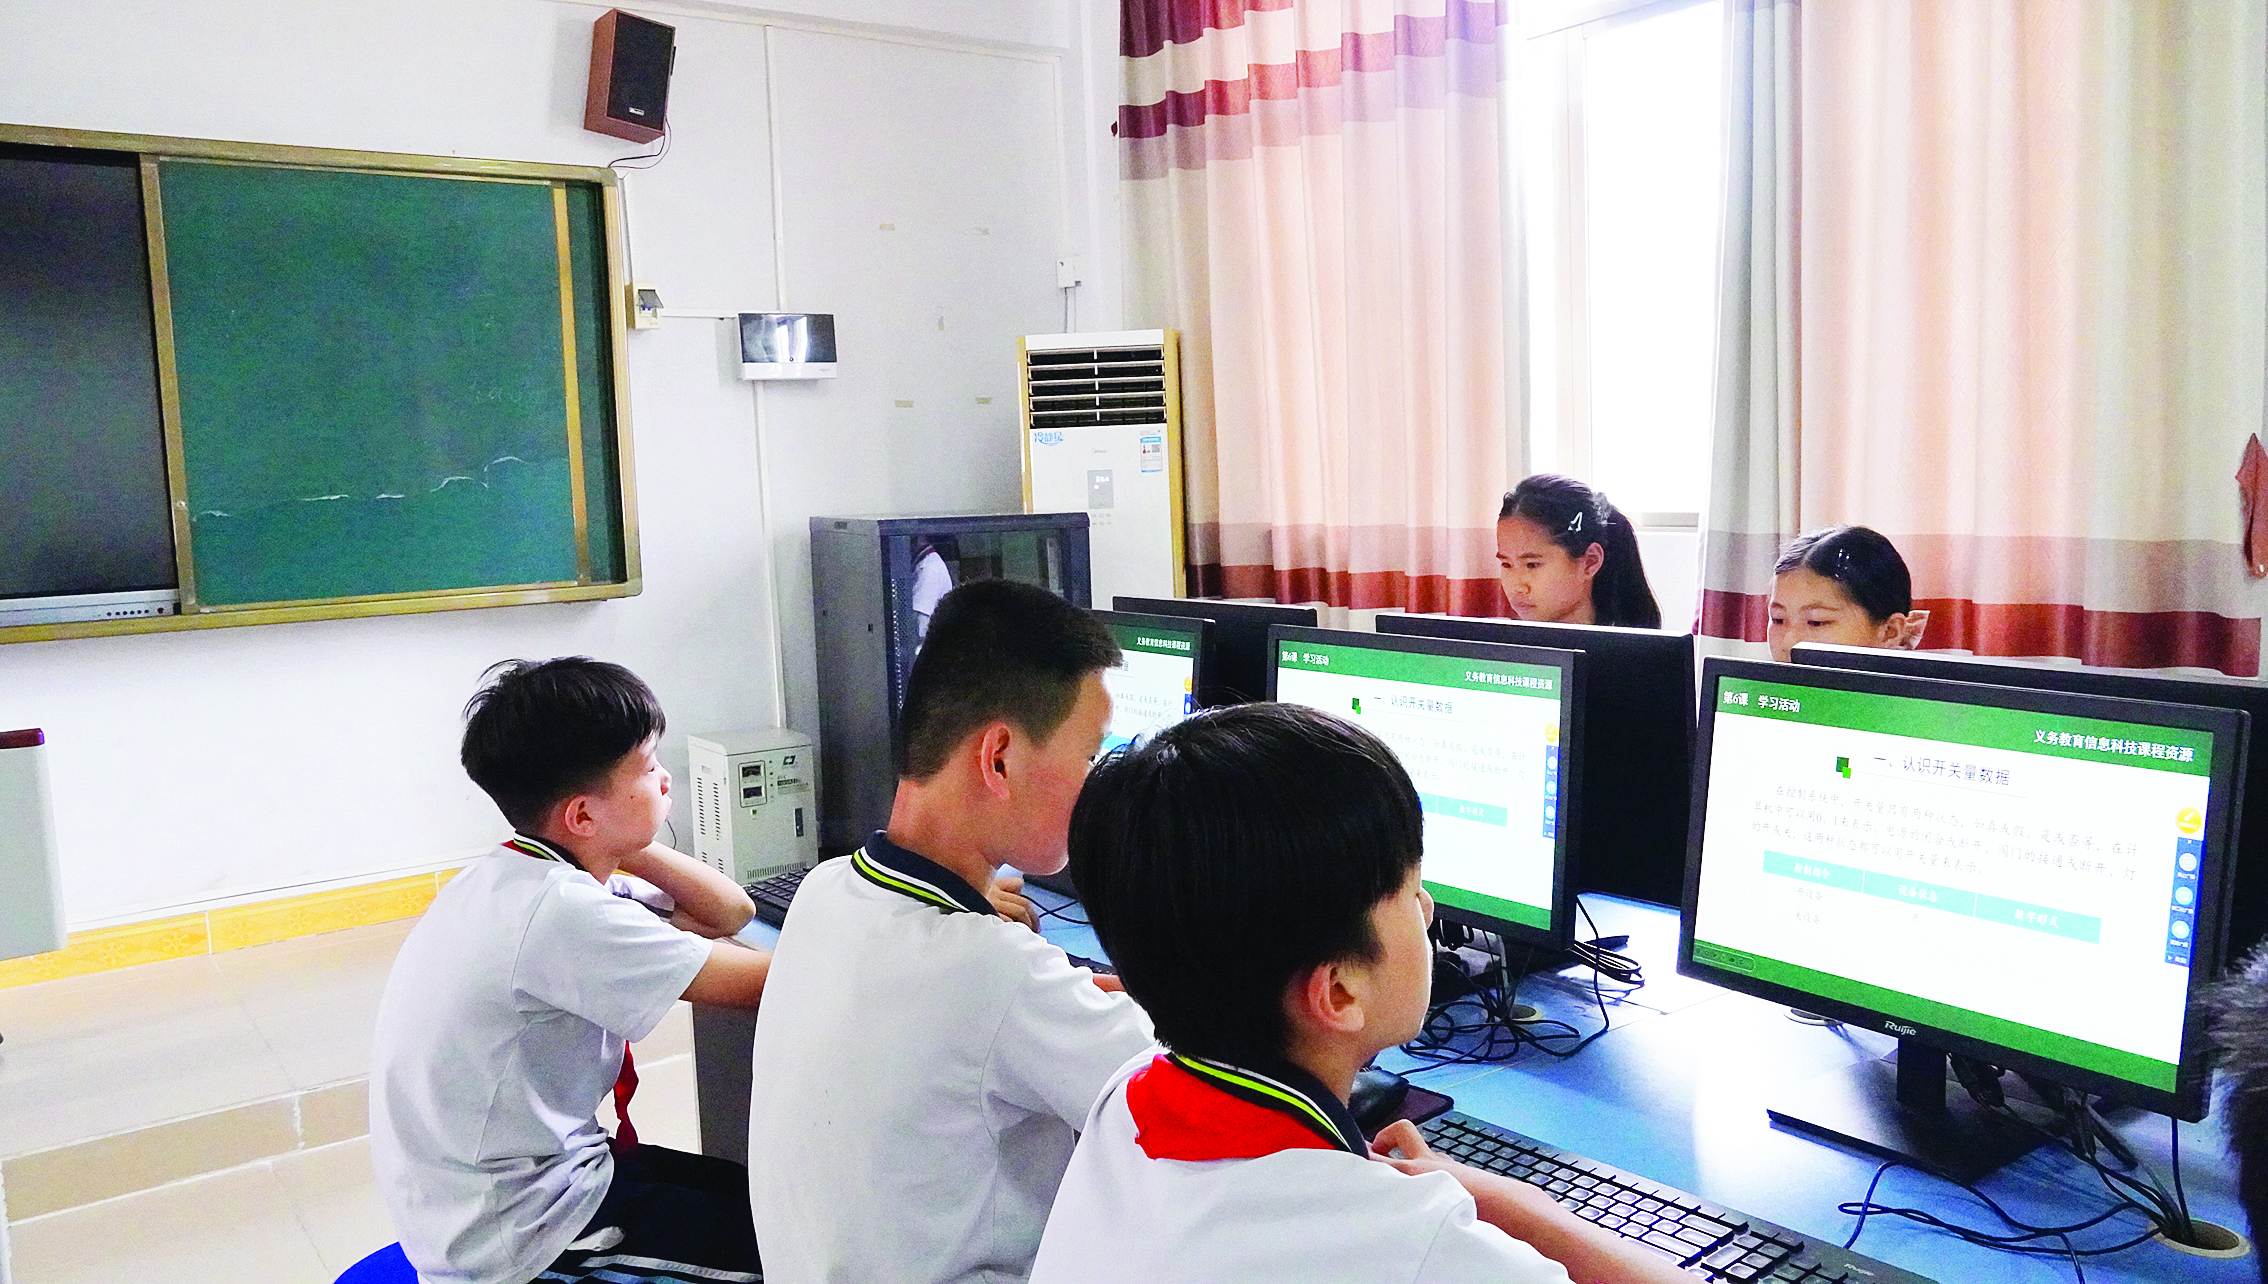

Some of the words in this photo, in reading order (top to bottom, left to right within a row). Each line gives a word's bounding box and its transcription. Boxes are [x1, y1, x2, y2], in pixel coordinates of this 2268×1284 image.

[1281, 650, 1299, 665] 第6课
[1302, 652, 1331, 668] 学习活动
[1464, 670, 1554, 691] 义务教育信息科技课程资源
[1372, 693, 1454, 715] 一、认识开关量数据
[1722, 690, 1750, 709] 第6课
[1757, 694, 1801, 714] 学习活动
[2033, 728, 2196, 764] 义务教育信息科技课程资源
[1873, 754, 2012, 787] 一、认识开关量数据
[1793, 862, 1831, 880] 控制指令
[1796, 886, 1824, 902] 开设备
[1898, 883, 1938, 903] 设备状态
[1794, 909, 1820, 925] 关设备
[2014, 907, 2060, 930] 数字形式
[1884, 1020, 1917, 1036] Ruijie
